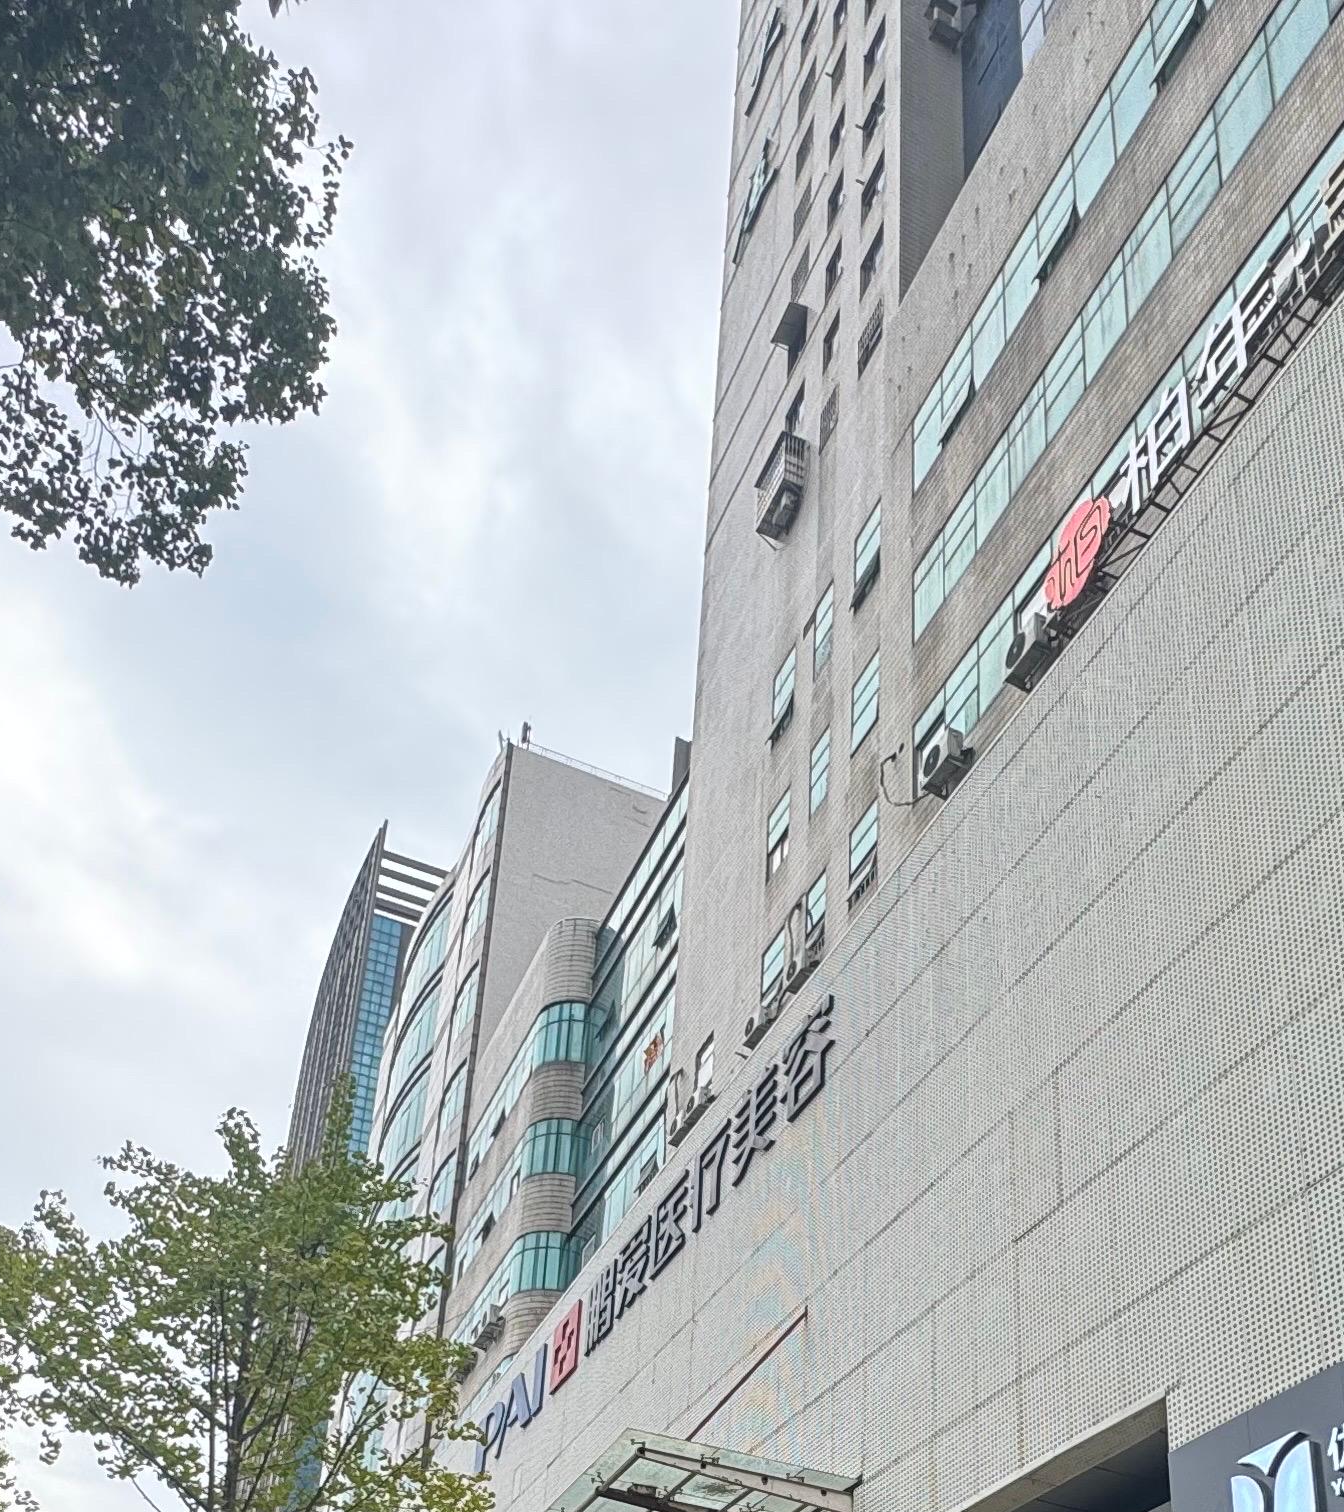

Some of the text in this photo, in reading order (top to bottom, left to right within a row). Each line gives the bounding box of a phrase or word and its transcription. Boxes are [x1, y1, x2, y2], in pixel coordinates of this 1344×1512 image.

[585, 994, 835, 1357] 鹏爱医疗美容
